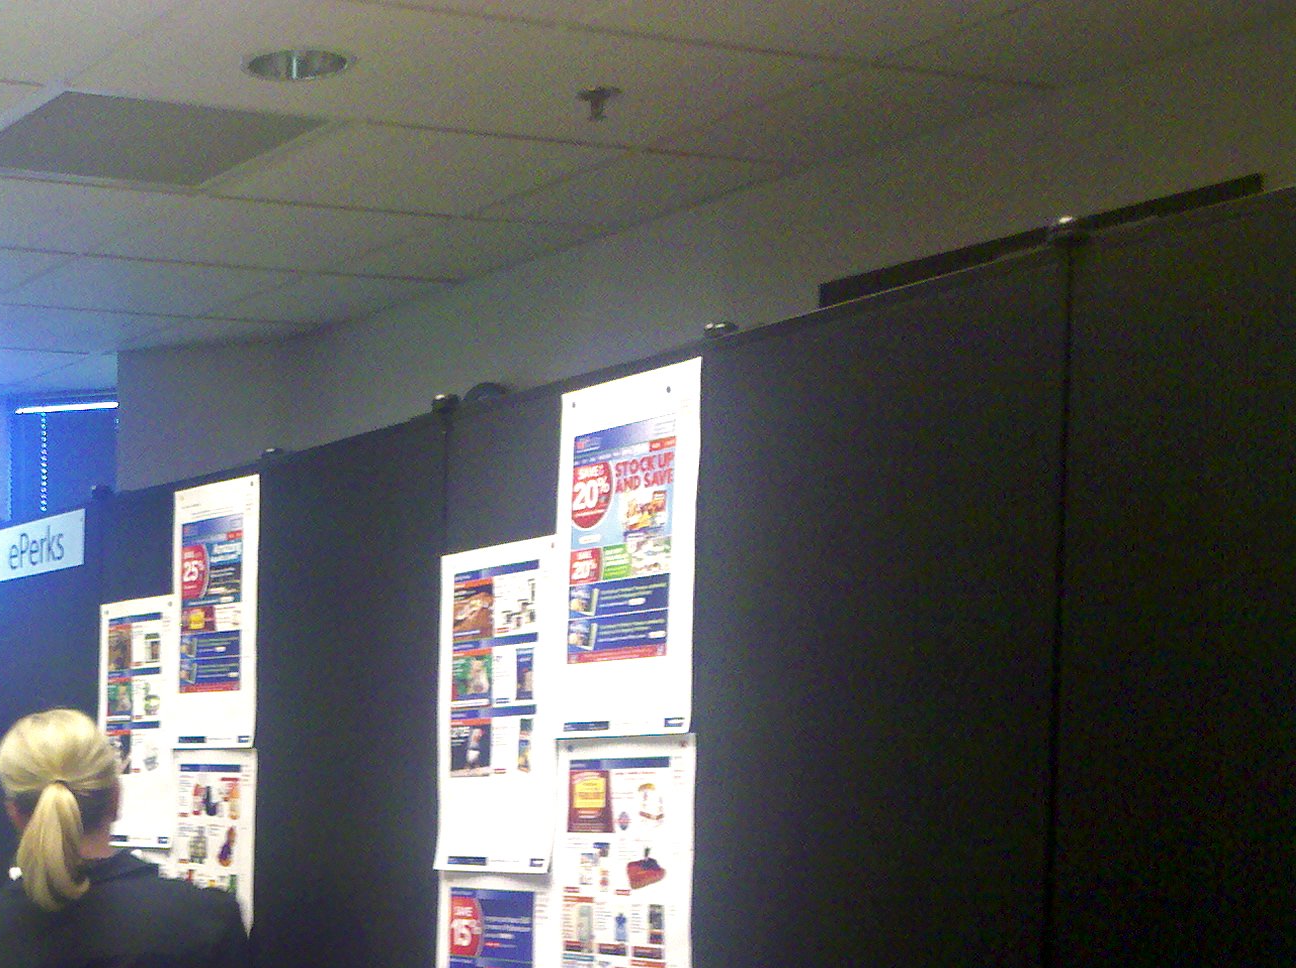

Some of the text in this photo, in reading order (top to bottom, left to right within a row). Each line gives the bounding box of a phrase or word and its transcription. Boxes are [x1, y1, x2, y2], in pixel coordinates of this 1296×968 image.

[615, 456, 656, 477] STOCK
[657, 451, 674, 469] UP
[615, 468, 674, 493] AND SAVE
[9, 525, 64, 569] ePerks
